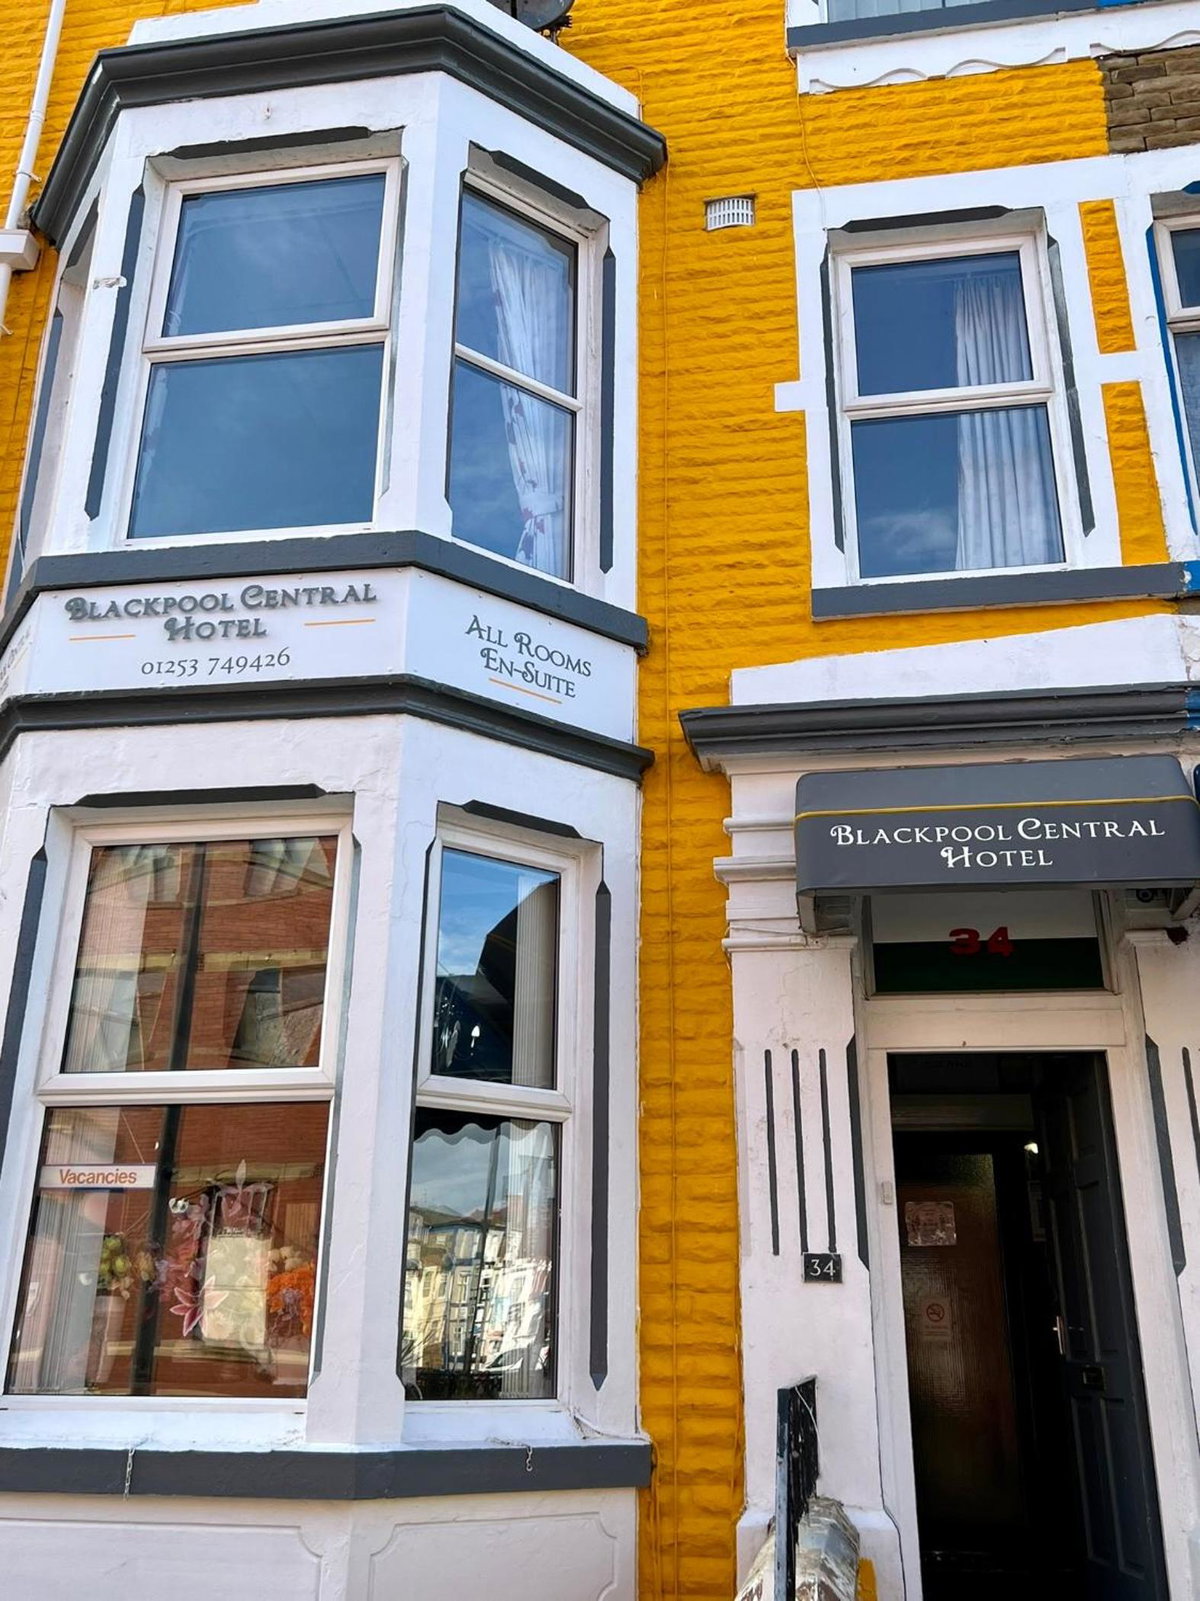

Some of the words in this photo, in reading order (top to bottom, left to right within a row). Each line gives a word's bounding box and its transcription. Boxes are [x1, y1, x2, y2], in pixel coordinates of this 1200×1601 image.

[64, 591, 234, 621] BLACKPOOL
[240, 583, 377, 610] CENTRAL
[163, 615, 267, 641] HOTEL
[465, 614, 508, 648] ALL
[513, 631, 592, 677] ROOMS
[141, 656, 199, 677] 01253
[208, 646, 291, 675] 749426
[829, 823, 1013, 846] BLACKPOOL
[1016, 816, 1166, 842] CENTRAL
[940, 845, 1054, 870] HOTEL
[948, 926, 1016, 958] 34
[59, 1168, 137, 1185] Vacancies
[809, 1258, 836, 1276] 34
